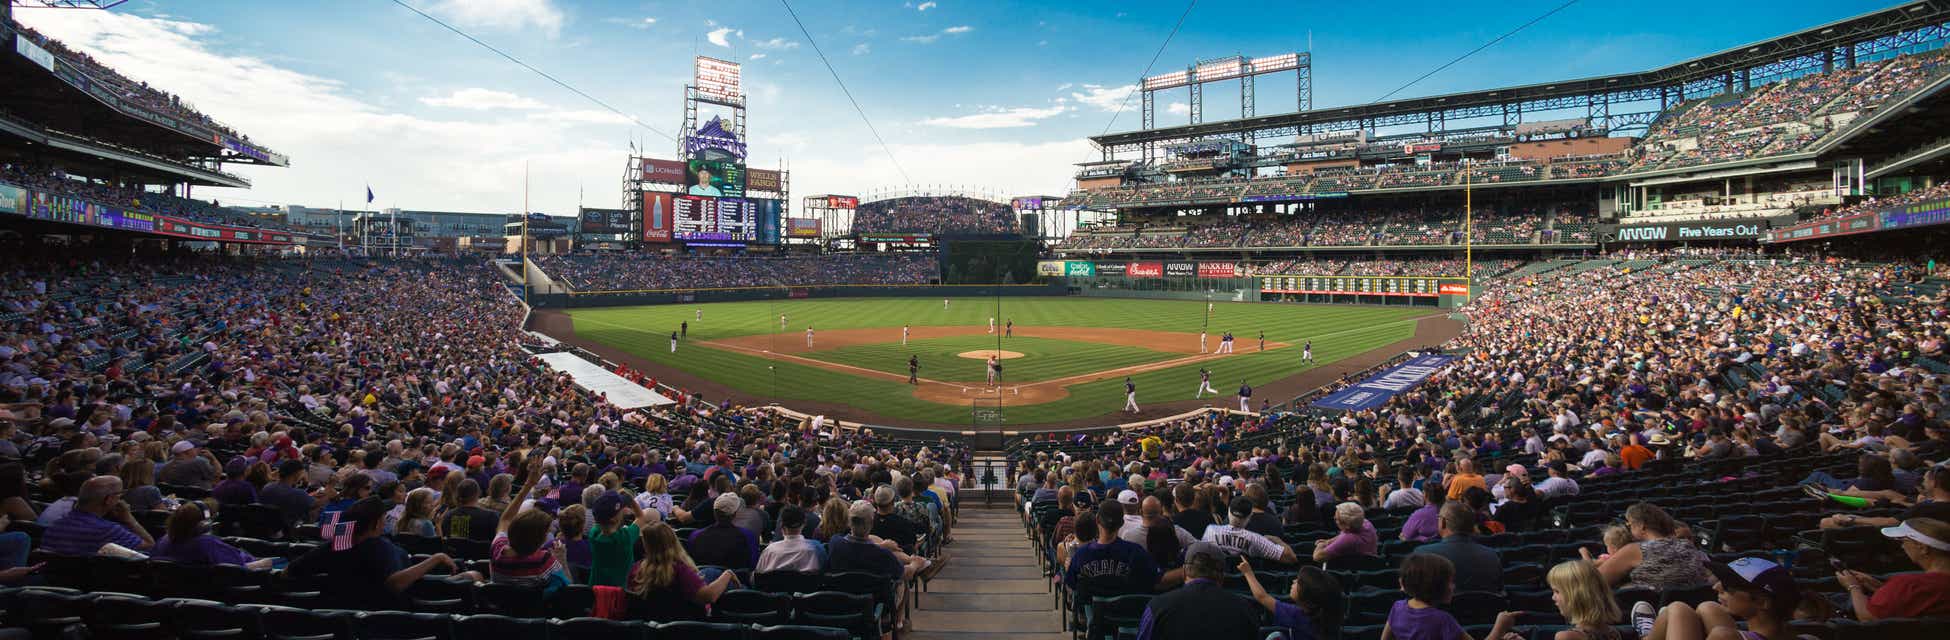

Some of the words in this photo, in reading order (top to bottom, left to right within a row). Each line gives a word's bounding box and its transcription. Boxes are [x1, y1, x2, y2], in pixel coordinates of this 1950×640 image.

[750, 171, 777, 180] WELLS
[750, 179, 776, 187] FARGO
[1619, 226, 1668, 240] ARROW
[1679, 227, 1702, 238] Five
[1702, 225, 1734, 237] Years
[1736, 224, 1759, 235] Out
[1167, 263, 1193, 271] ARROW
[648, 497, 658, 509] 2
[1215, 533, 1249, 550] LINTON
